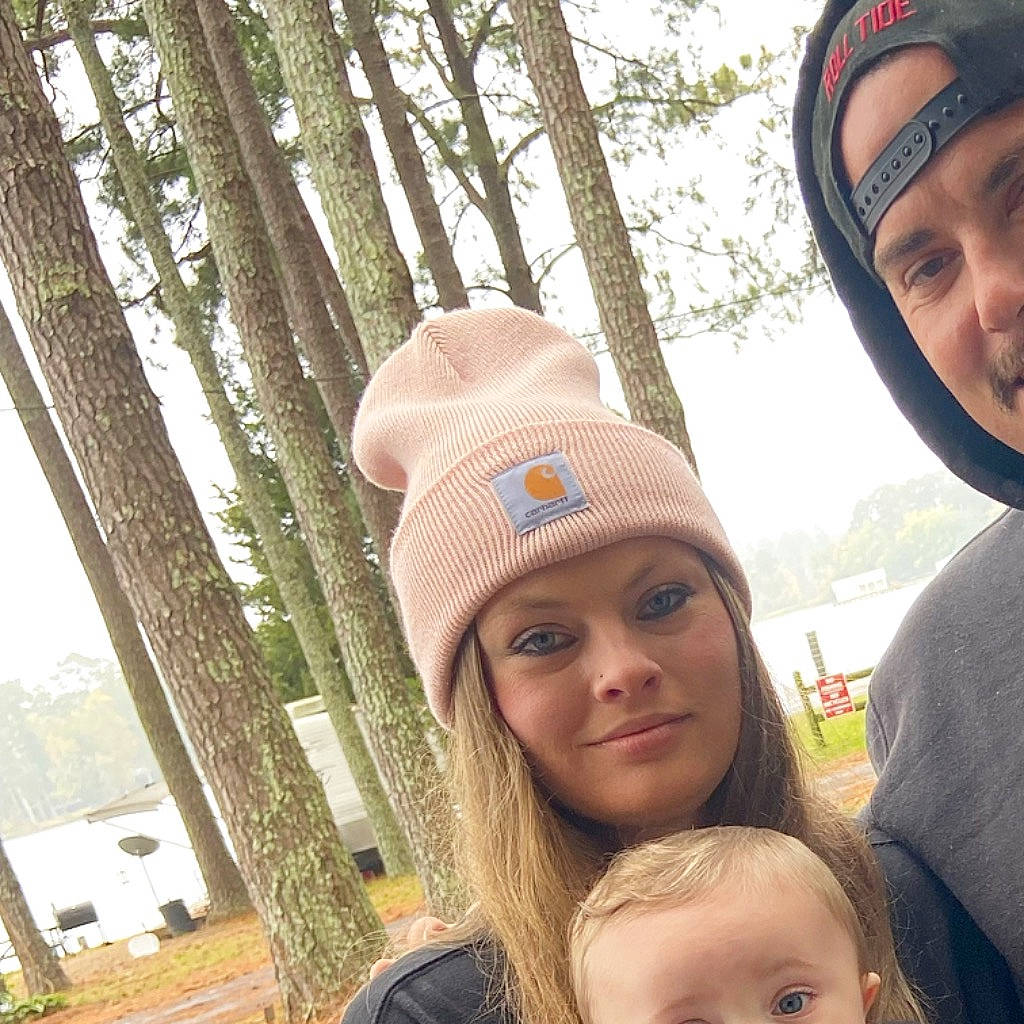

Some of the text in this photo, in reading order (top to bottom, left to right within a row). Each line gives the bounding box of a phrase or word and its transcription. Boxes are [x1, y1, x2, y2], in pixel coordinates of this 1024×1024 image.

[824, 0, 918, 104] ROLL TIDE
[524, 496, 569, 518] carhartt
